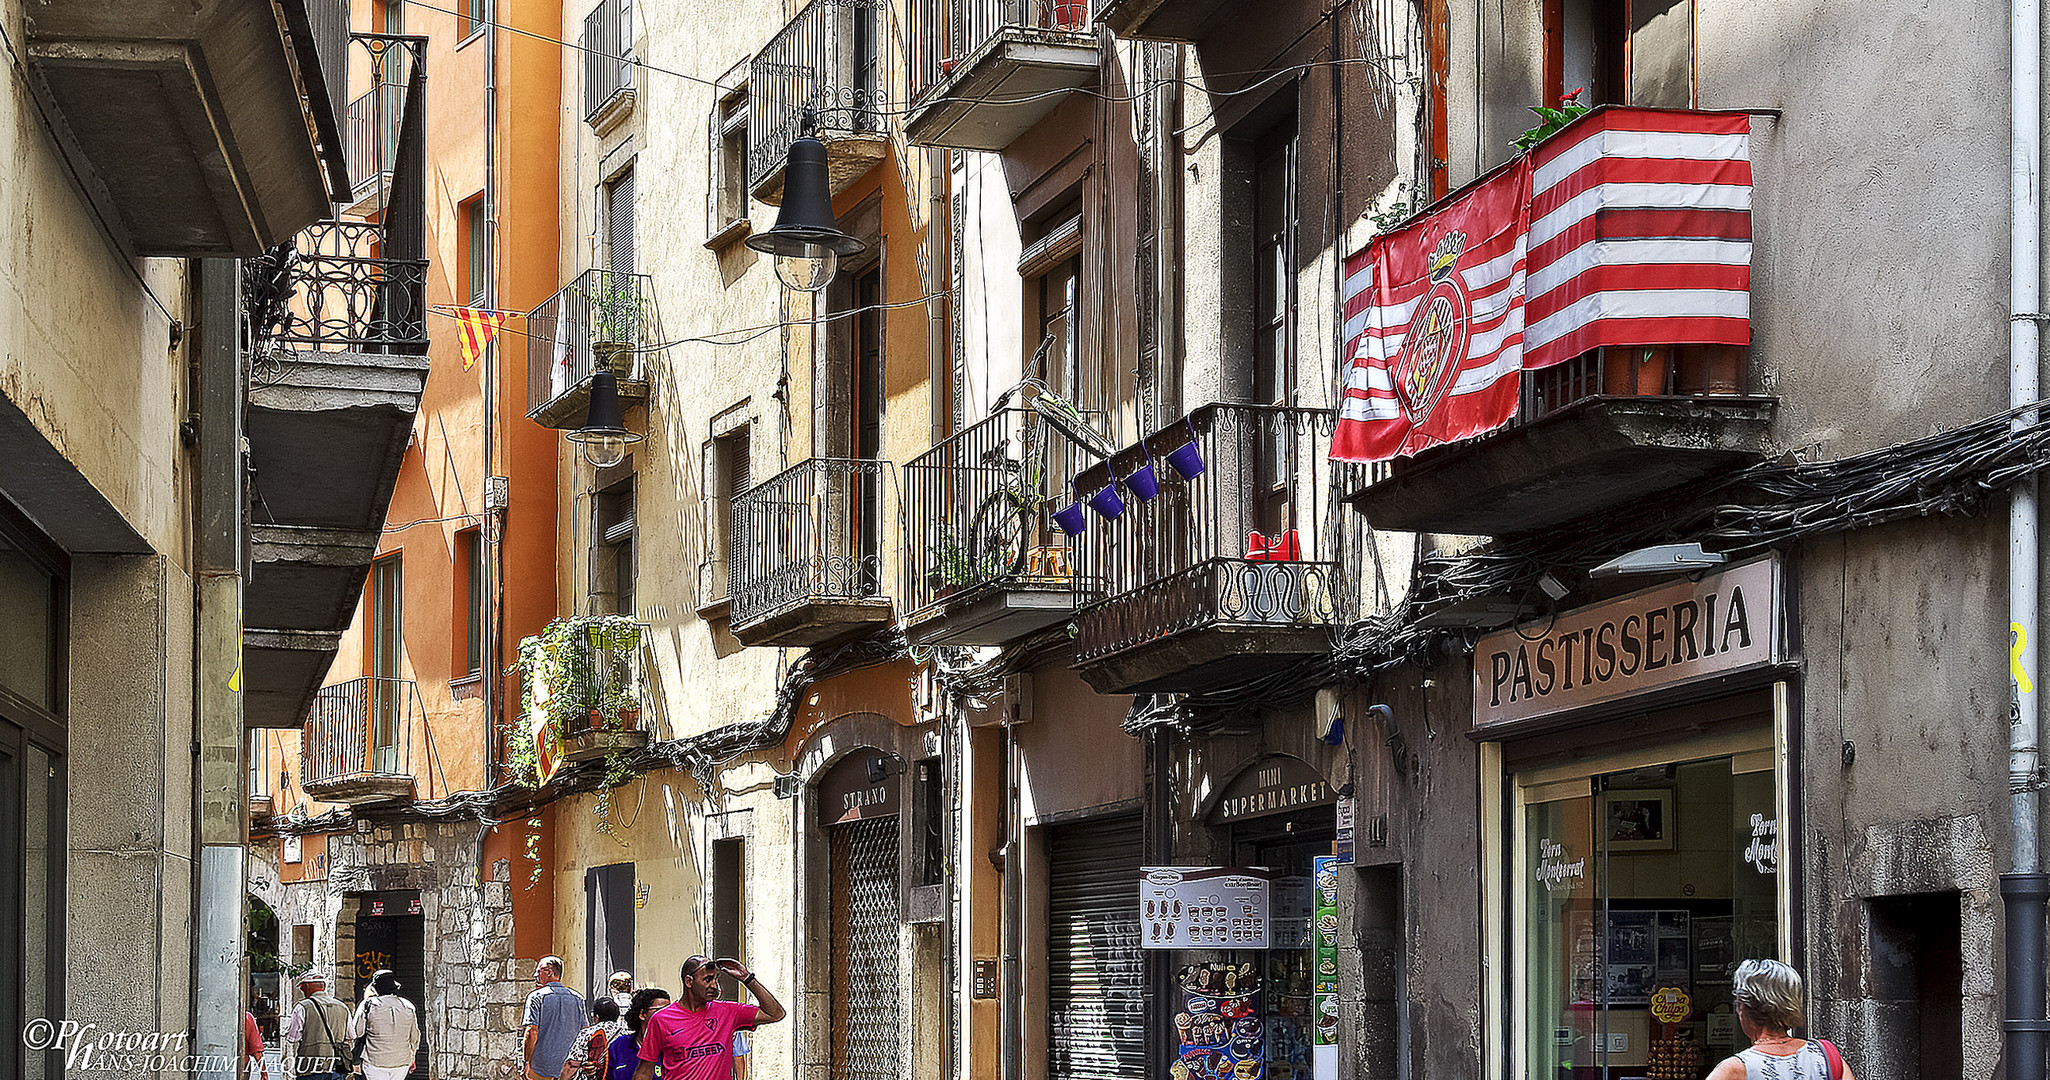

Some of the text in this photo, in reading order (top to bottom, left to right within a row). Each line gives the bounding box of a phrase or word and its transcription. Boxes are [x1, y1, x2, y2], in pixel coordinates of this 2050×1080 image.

[1488, 584, 1753, 707] PASTISSERIA
[1258, 767, 1281, 789] MINI
[843, 786, 886, 810] STRANO
[1223, 781, 1326, 818] SUPERMARKET
[1655, 1004, 1685, 1017] Chups
